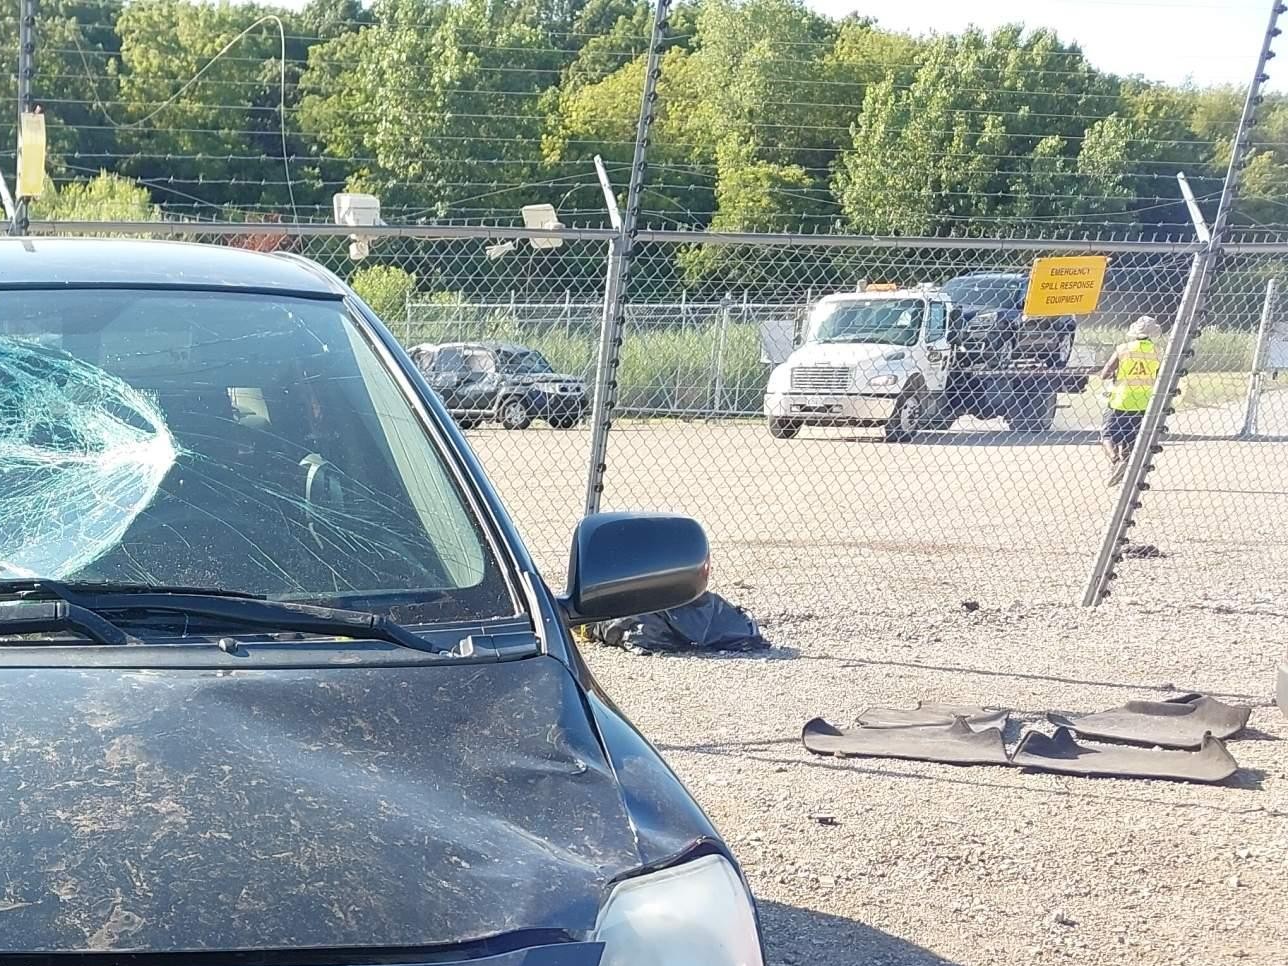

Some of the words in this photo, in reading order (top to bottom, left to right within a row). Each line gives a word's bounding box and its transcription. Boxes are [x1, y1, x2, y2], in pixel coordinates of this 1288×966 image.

[1050, 267, 1090, 276] EMERGENCY
[1040, 282, 1058, 290] SPILL
[1059, 280, 1095, 289] RESPONSE
[1045, 294, 1084, 304] EQUIPMENT
